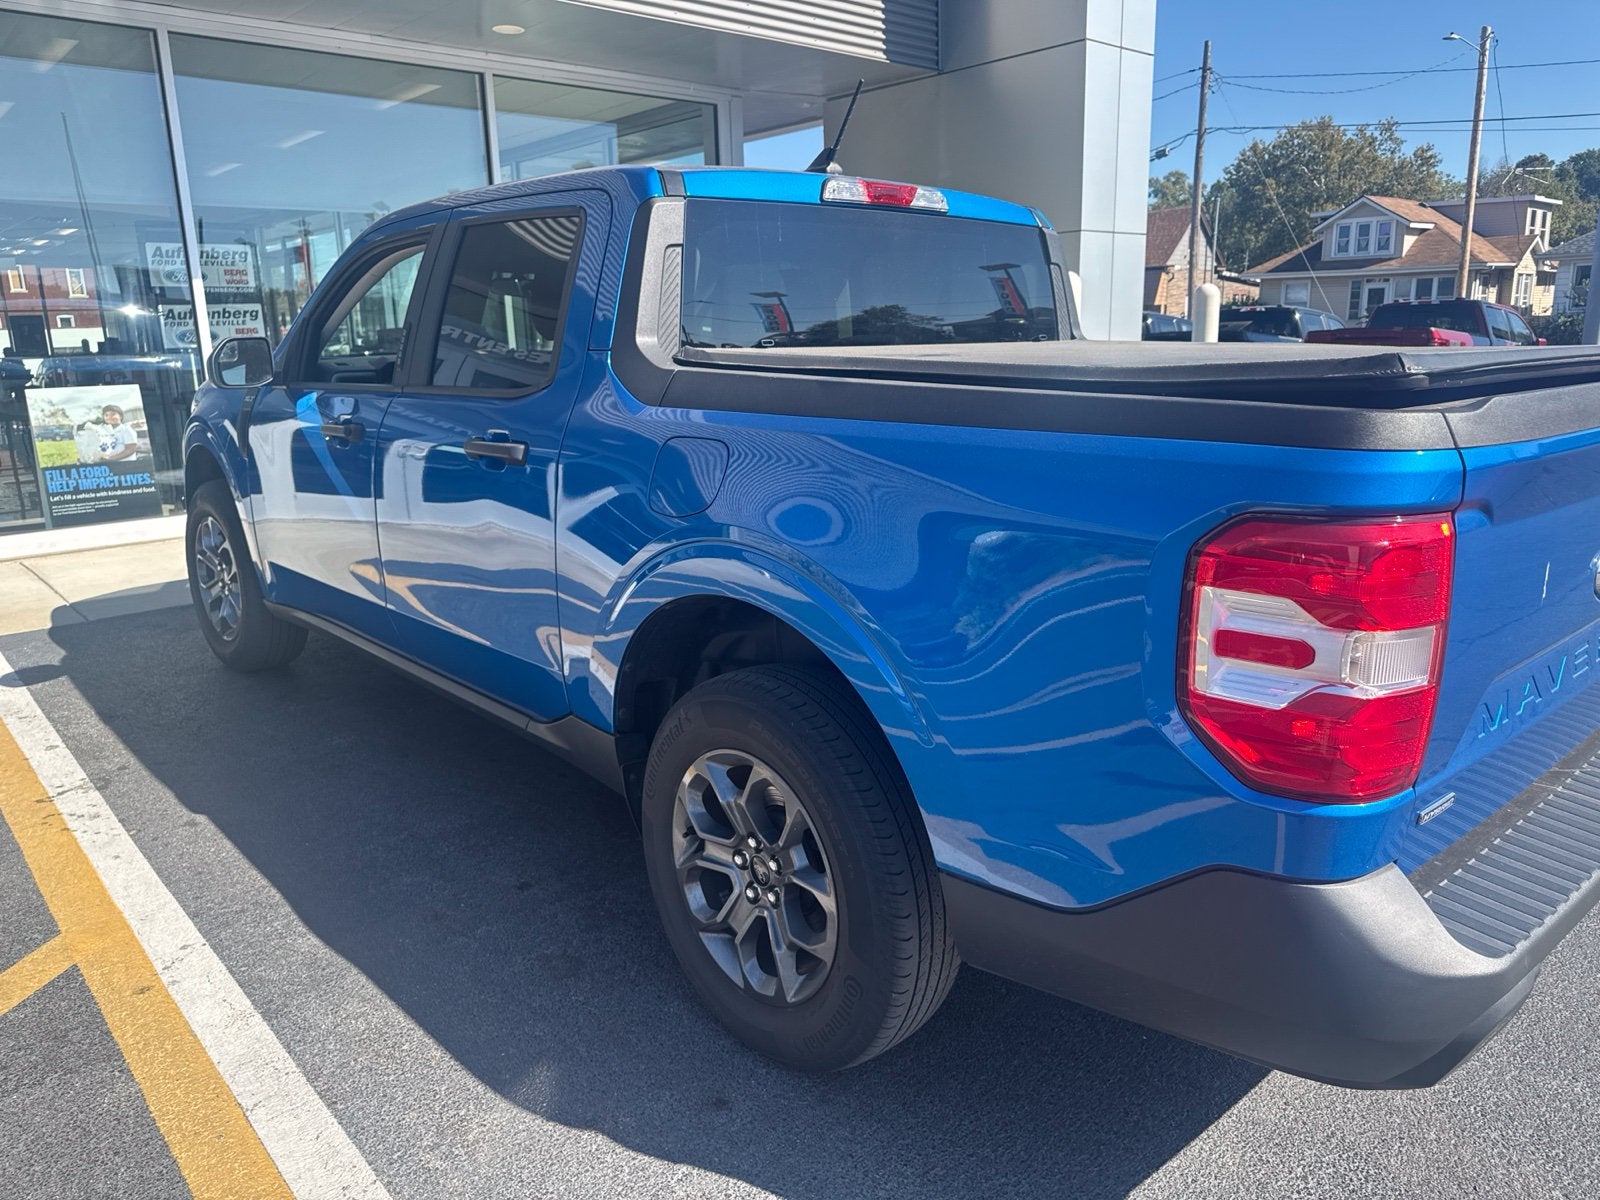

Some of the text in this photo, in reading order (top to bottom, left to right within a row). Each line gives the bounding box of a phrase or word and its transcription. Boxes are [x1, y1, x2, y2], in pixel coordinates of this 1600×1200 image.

[45, 465, 113, 480] FILL A FORD.
[48, 473, 155, 493] HELP IMPACT LIVES.
